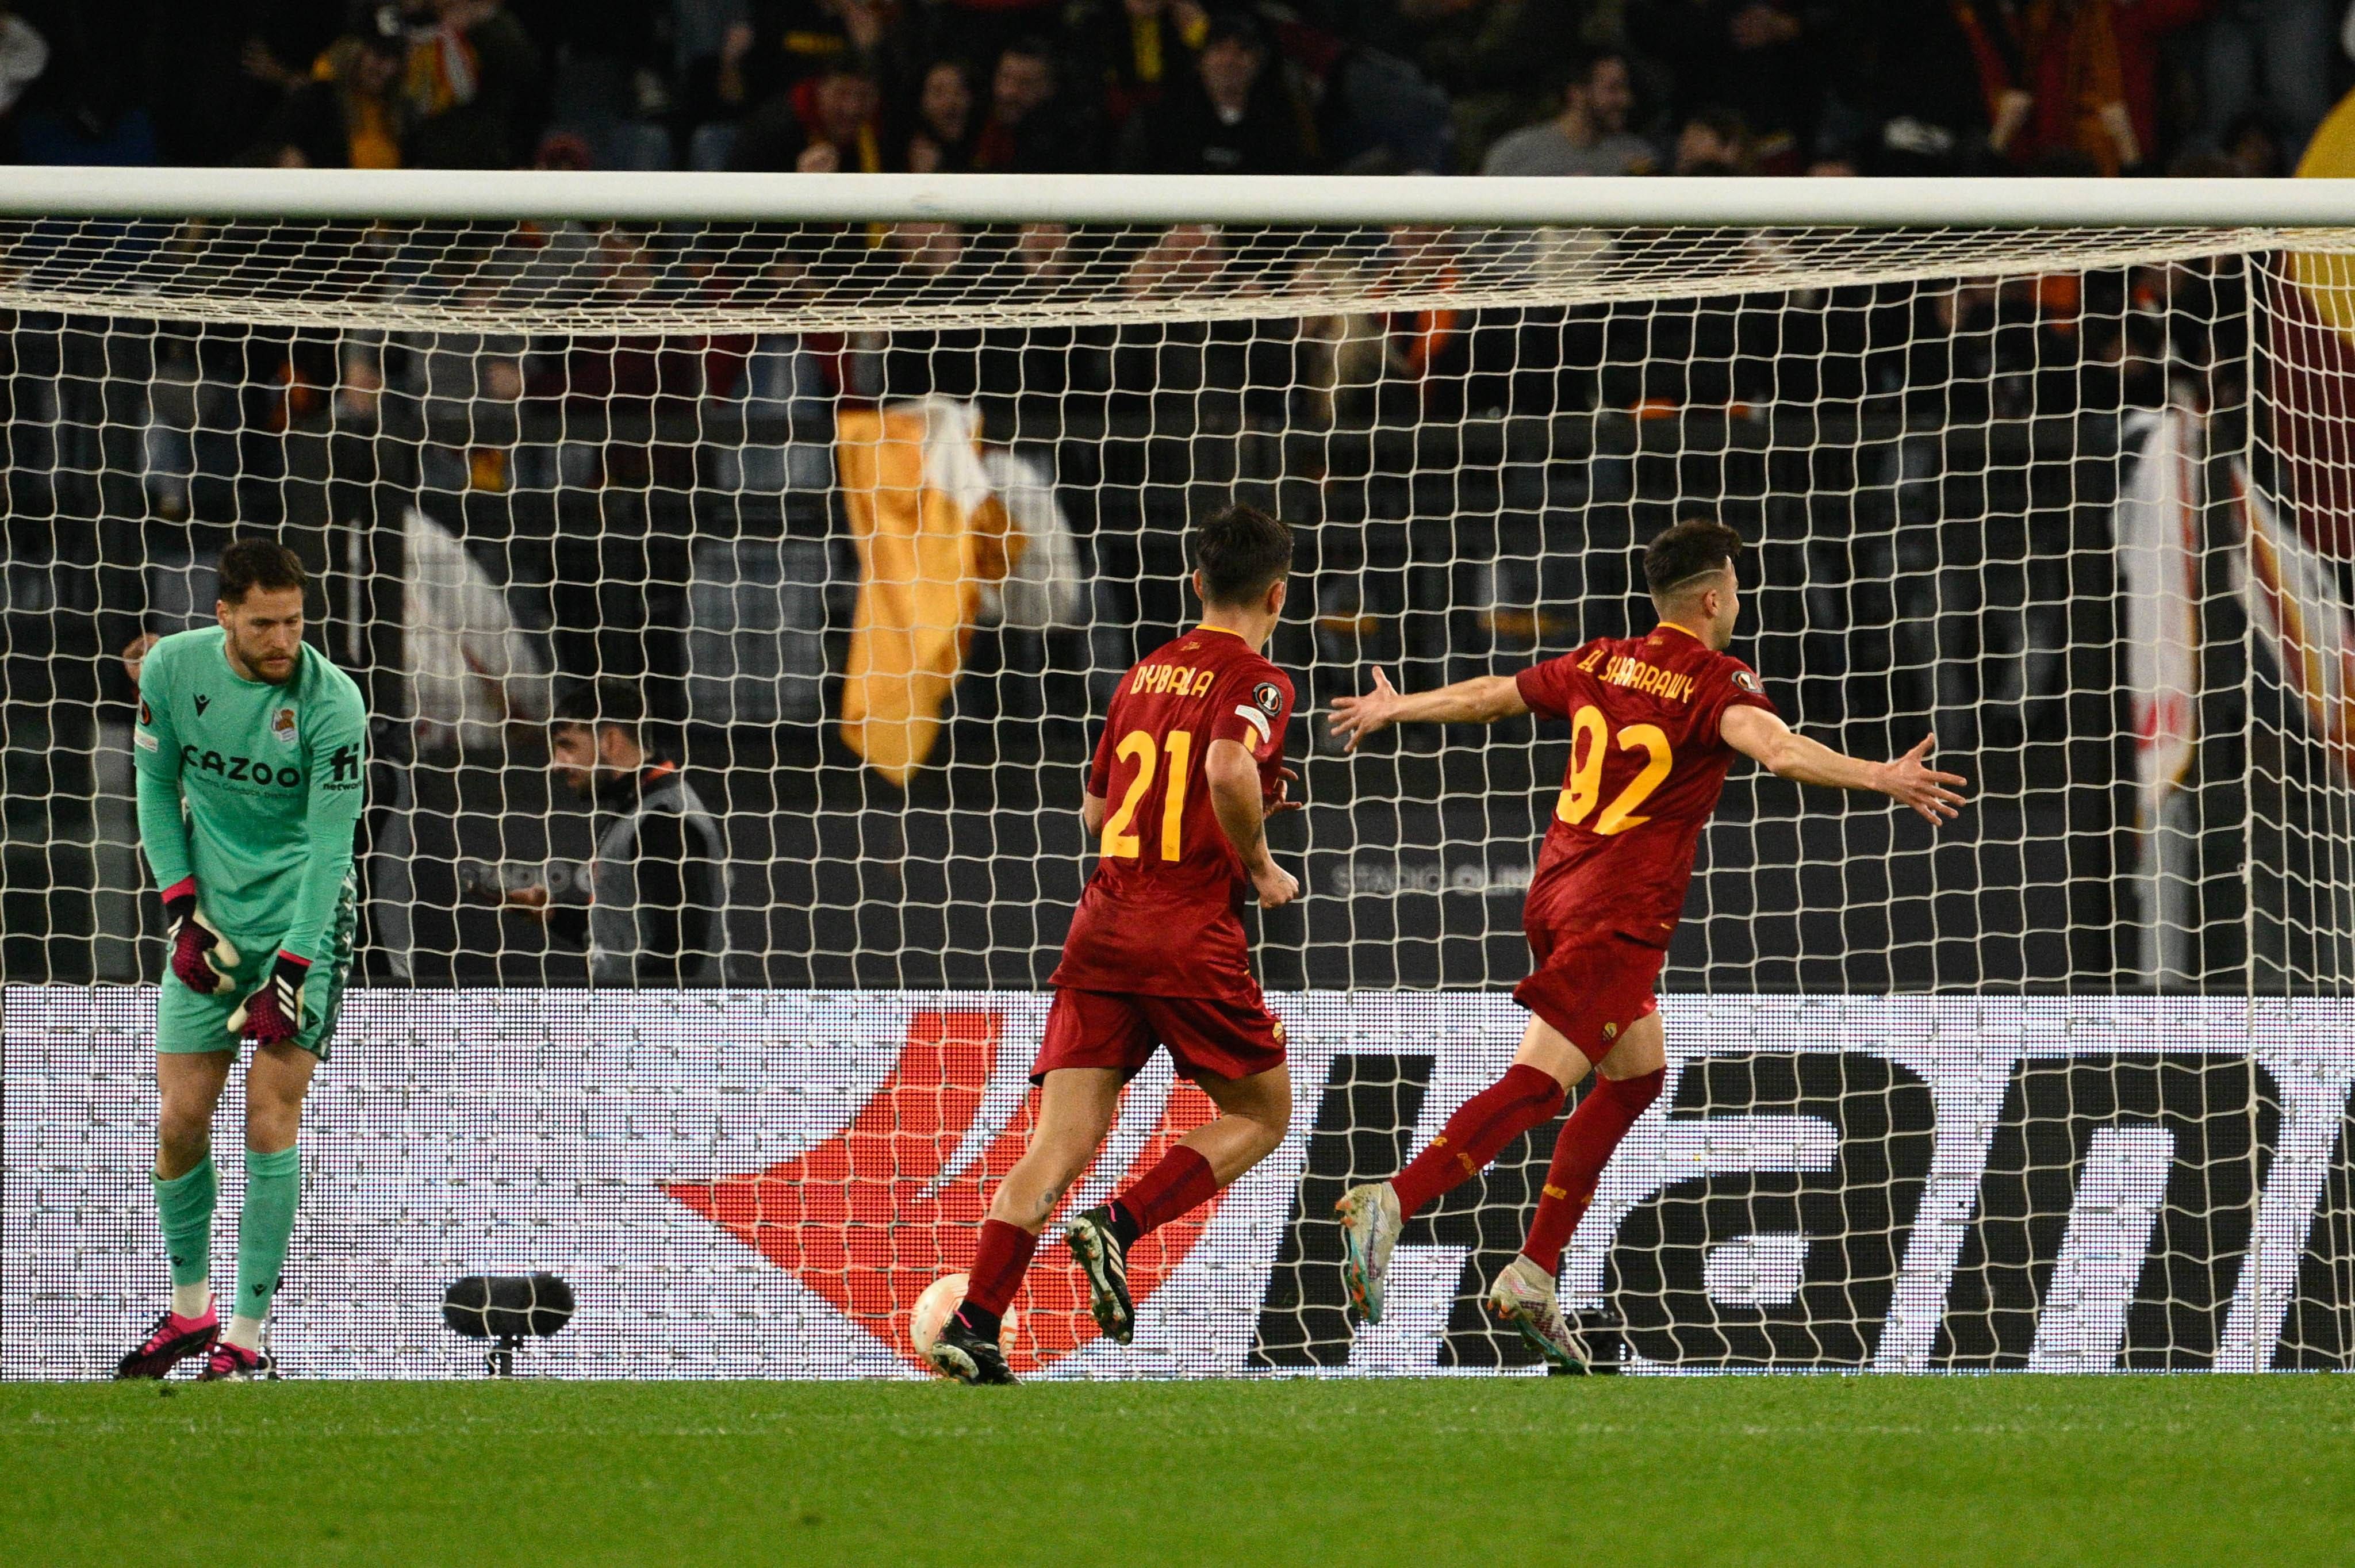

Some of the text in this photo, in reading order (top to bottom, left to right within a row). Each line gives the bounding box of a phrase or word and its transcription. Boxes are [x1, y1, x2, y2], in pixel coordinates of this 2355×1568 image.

[1129, 664, 1214, 698] DYBALA
[1577, 649, 1696, 704] EL SHAARAWY
[182, 744, 300, 788] CAZOO
[323, 781, 362, 791] networ
[1556, 705, 1673, 835] 92
[1100, 730, 1191, 862] 21
[1248, 1053, 2355, 1370] Han
